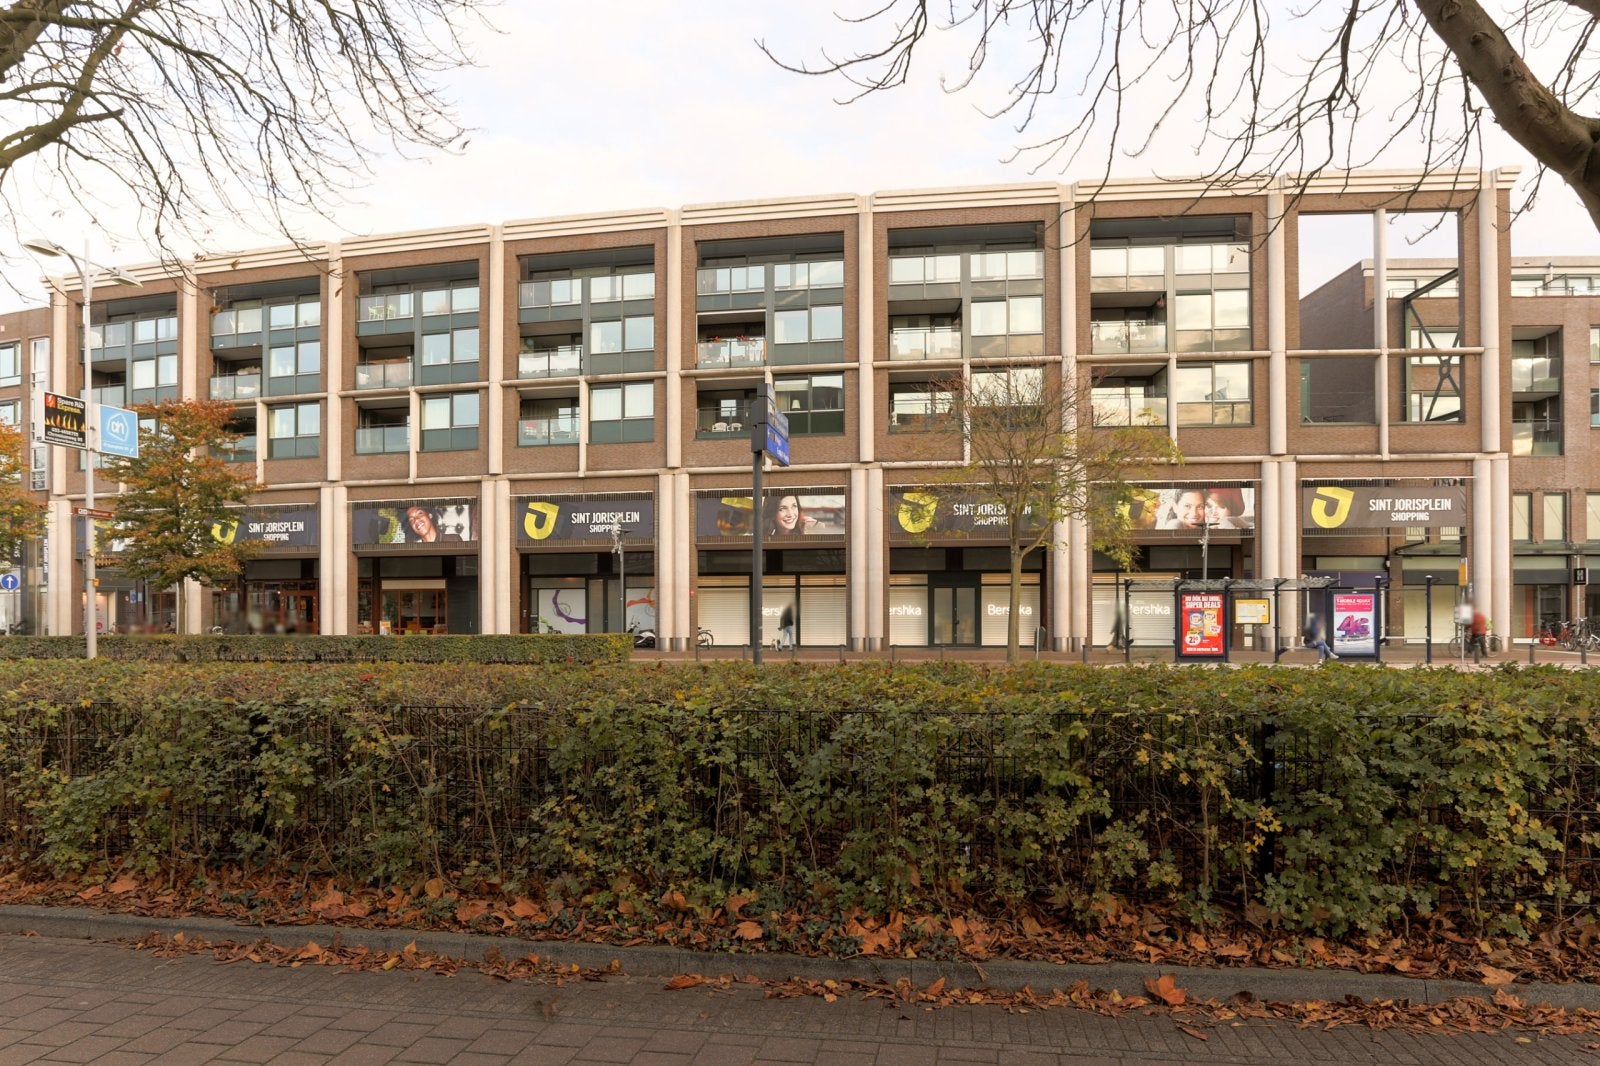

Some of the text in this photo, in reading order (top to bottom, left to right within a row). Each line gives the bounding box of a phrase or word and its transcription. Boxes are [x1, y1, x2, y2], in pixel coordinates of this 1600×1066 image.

[953, 503, 975, 516] SINT
[1369, 498, 1452, 511] SINT JORISPLEIN
[571, 512, 591, 524] SINT
[1391, 512, 1430, 522] SHOPPING
[248, 523, 264, 533] SINT
[263, 533, 290, 541] SHOPPING
[987, 604, 1033, 616] Berska
[1186, 601, 1221, 609] SUPER DEALS
